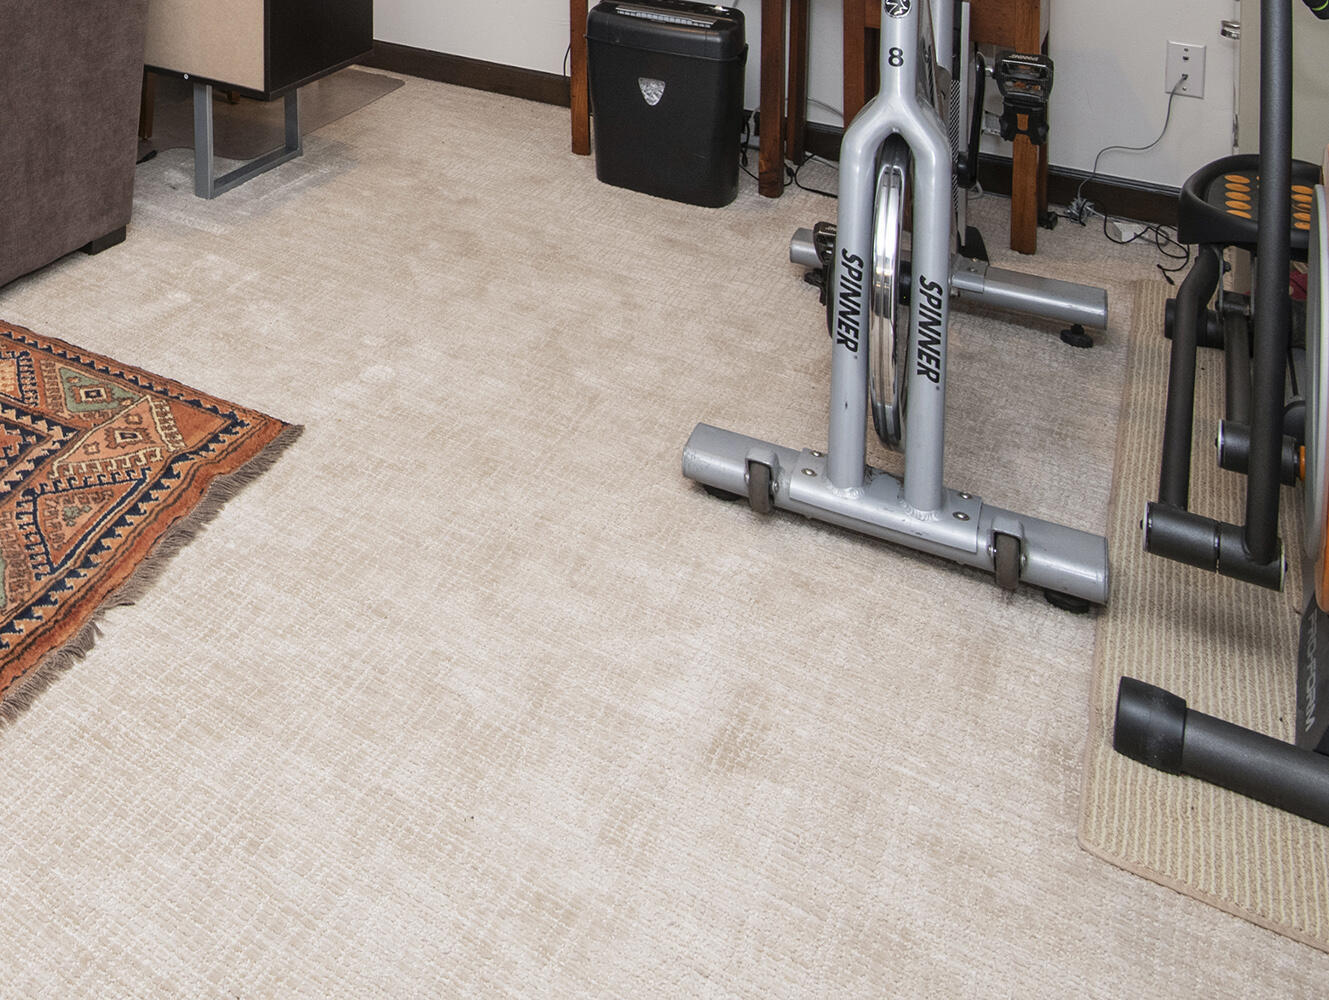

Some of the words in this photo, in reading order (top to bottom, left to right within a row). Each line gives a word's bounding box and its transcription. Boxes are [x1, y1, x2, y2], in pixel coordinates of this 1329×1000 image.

[888, 47, 904, 67] 8
[837, 247, 863, 353] SPINNER
[917, 274, 943, 384] SPINNER
